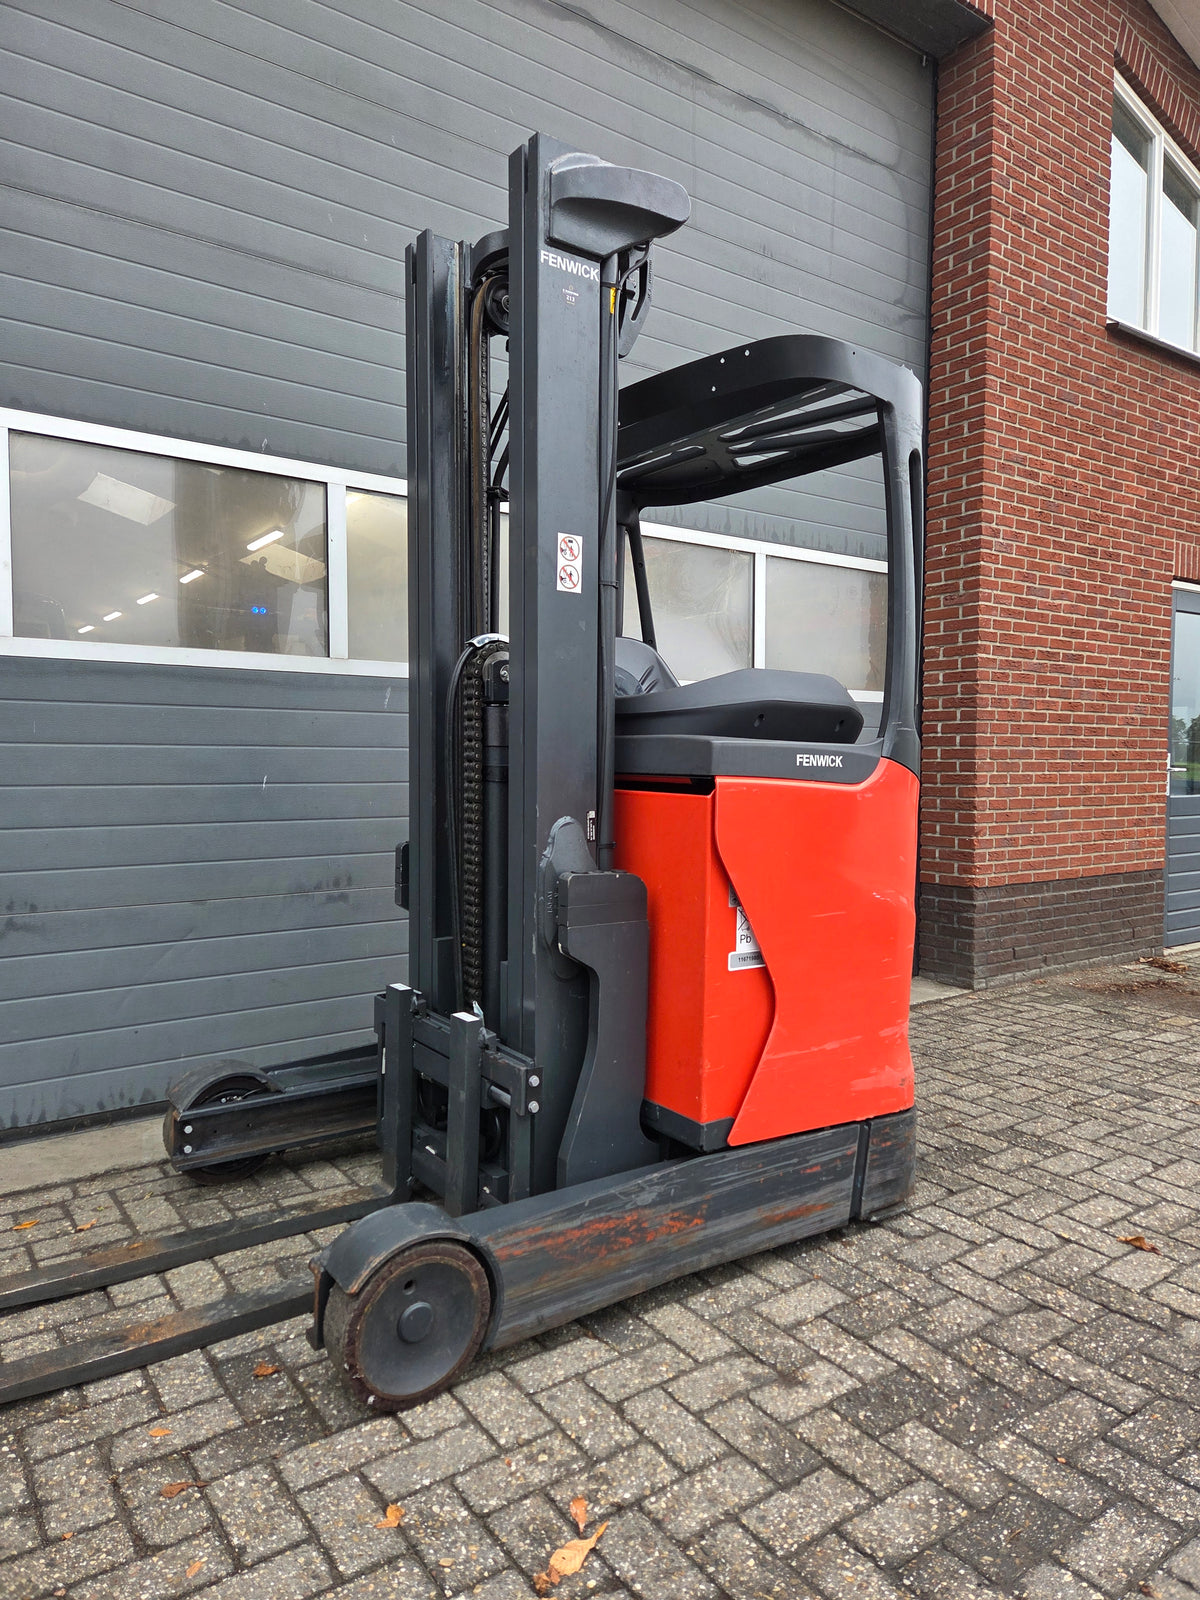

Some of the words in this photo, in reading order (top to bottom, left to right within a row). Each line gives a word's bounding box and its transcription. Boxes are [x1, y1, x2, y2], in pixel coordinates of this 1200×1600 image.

[540, 250, 599, 282] FENWICK
[796, 754, 843, 768] FENWICK
[739, 934, 752, 944] Pb
